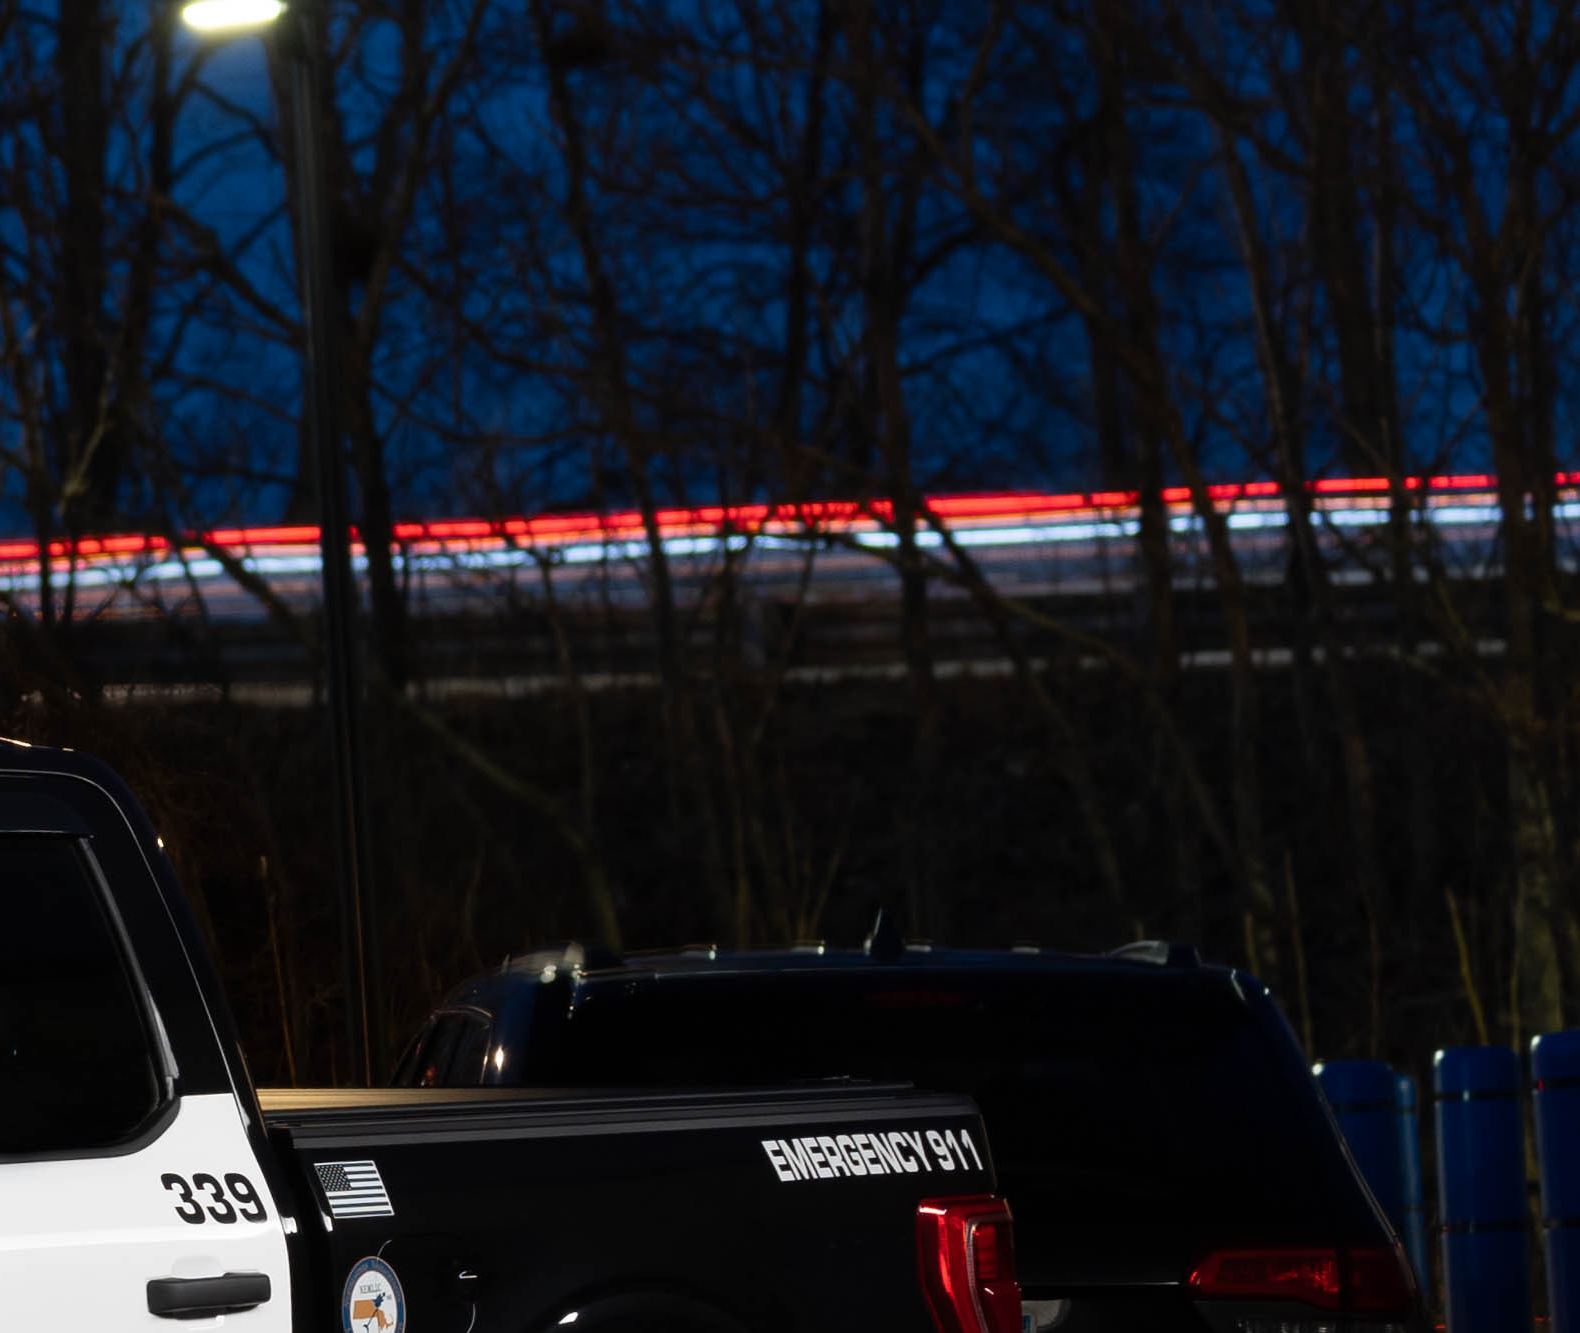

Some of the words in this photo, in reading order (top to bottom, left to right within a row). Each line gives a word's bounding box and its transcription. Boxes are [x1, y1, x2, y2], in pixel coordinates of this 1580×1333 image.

[761, 1131, 932, 1182] EMERGENCY
[925, 1129, 983, 1171] 911
[161, 1173, 267, 1225] 339
